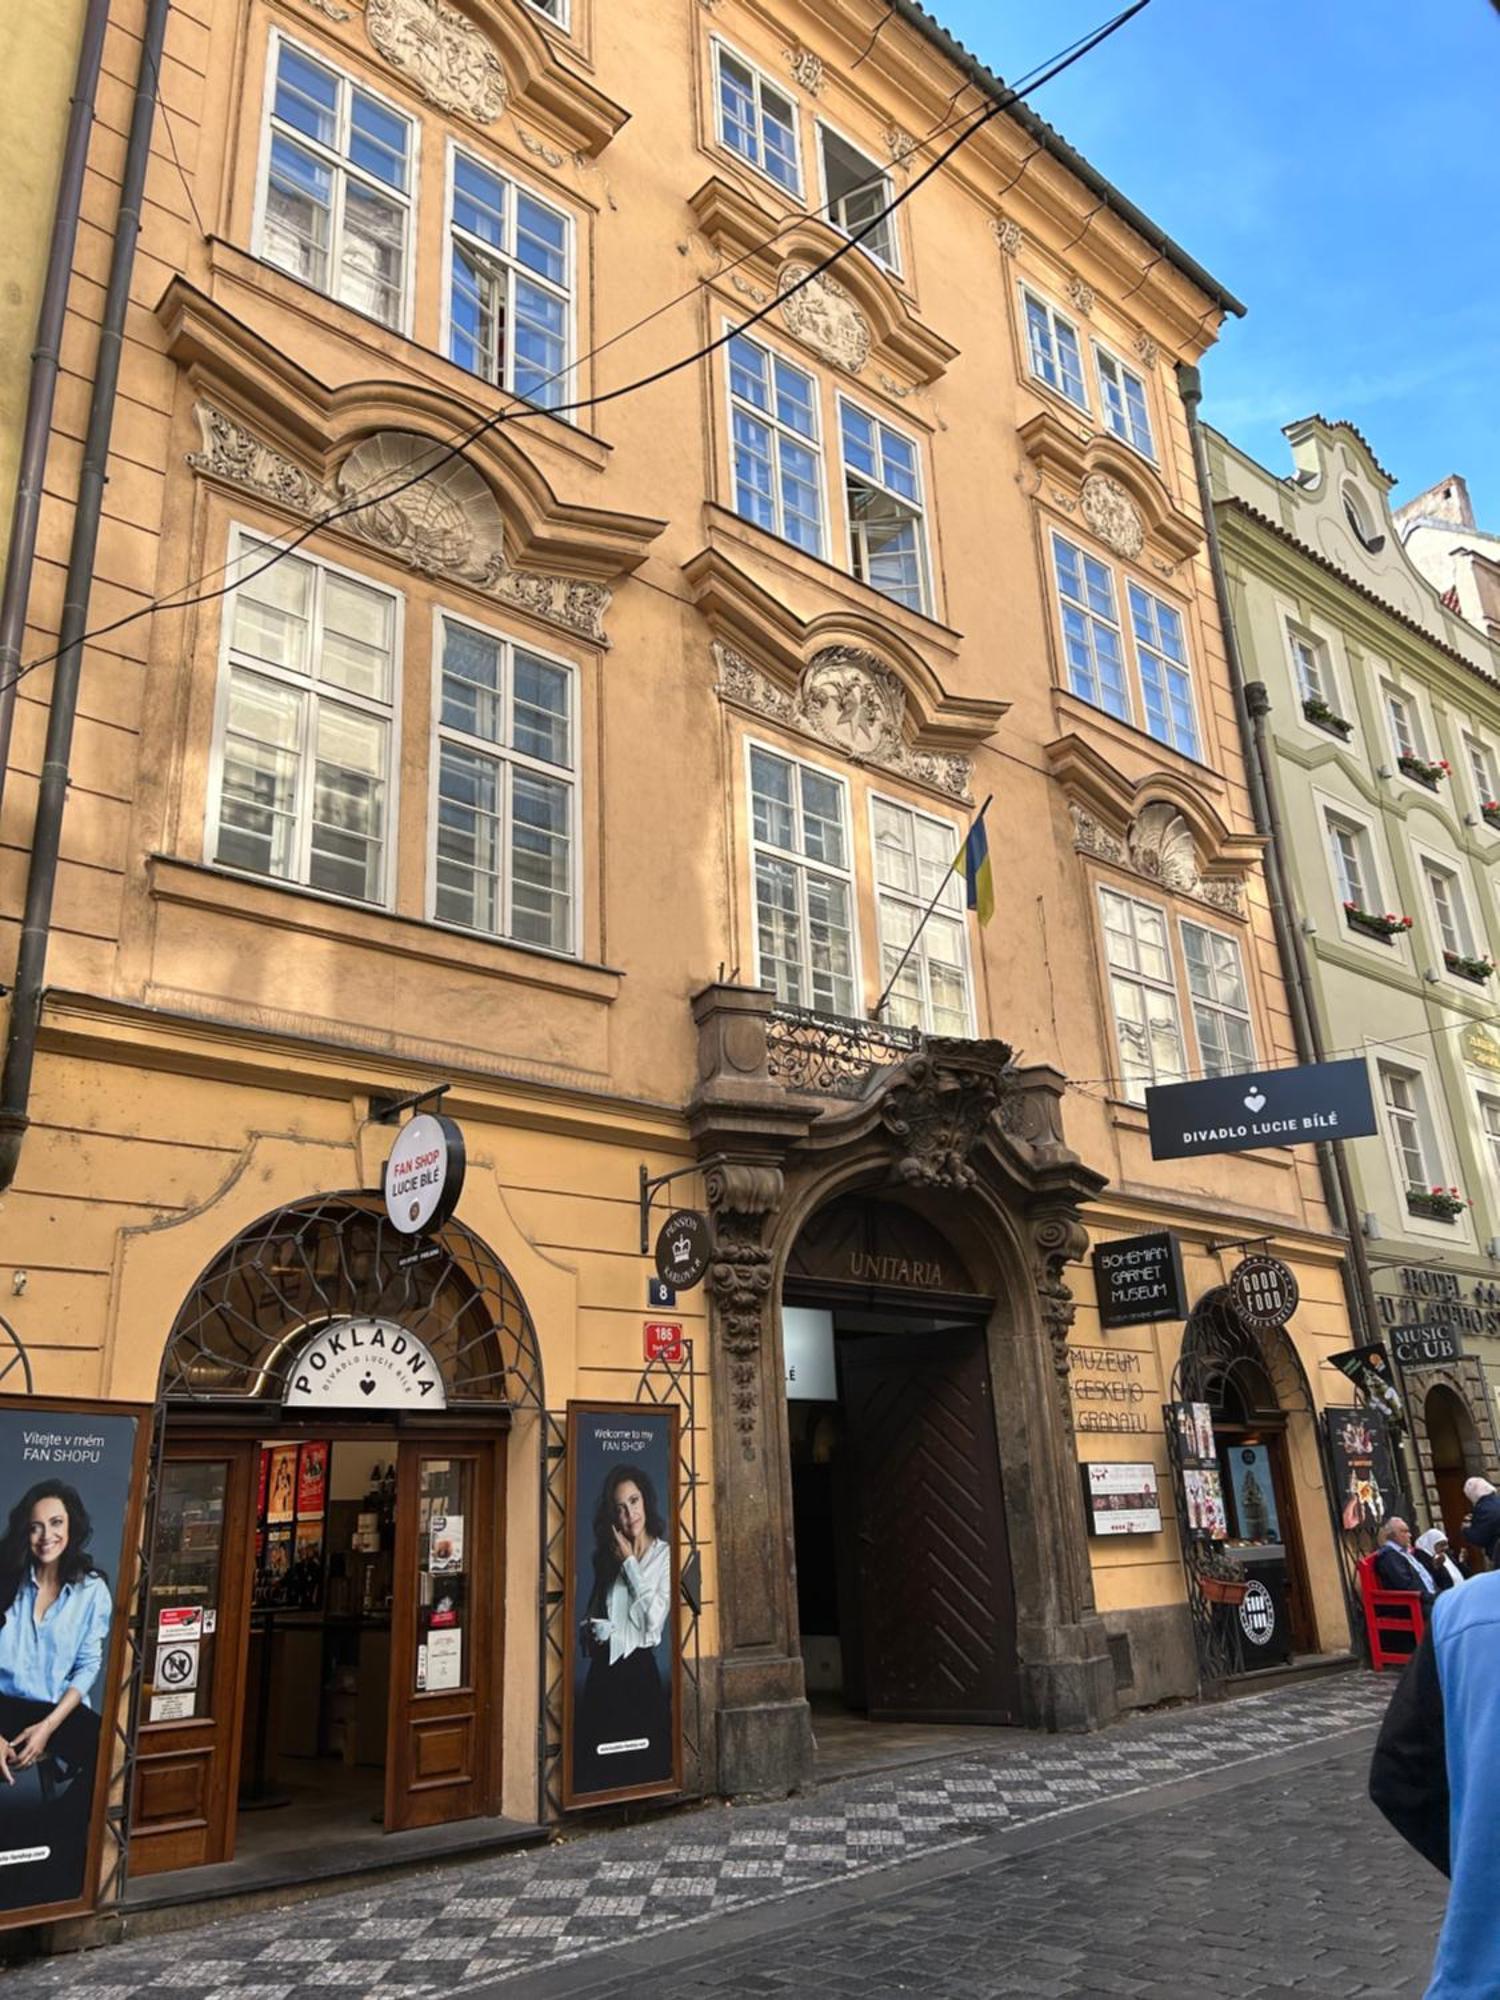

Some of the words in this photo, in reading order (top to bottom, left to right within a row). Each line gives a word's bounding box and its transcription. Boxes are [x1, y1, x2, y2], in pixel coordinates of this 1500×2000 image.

[1183, 1125, 1247, 1143] DIVADLO
[1253, 1119, 1297, 1135] LUCIE
[1303, 1111, 1339, 1129] BÍLÉ
[394, 1159, 413, 1177] FAN
[415, 1149, 440, 1170] SHOP
[392, 1176, 418, 1197] LUCIE
[420, 1164, 440, 1187] BÍLÉ
[665, 1215, 698, 1238] PENSION
[850, 1251, 943, 1286] UNITARIA
[1101, 1247, 1168, 1269] BOHEMIAN
[1111, 1265, 1161, 1286] GARNET
[1242, 1270, 1278, 1292] GOOD
[659, 1284, 668, 1300] 8
[1111, 1284, 1168, 1302] MUSEUM
[1246, 1291, 1282, 1312] FOOD
[1395, 1325, 1450, 1344] MUSIC
[295, 1328, 435, 1396] POKLADNA
[322, 1355, 360, 1391] DIVADLO
[365, 1354, 394, 1369] LUCIE
[1069, 1349, 1141, 1374] MUZEUM
[64, 1435, 72, 1445] v
[594, 1428, 631, 1439] Welcome
[631, 1429, 640, 1439] to
[23, 1447, 51, 1461] FAN
[53, 1449, 101, 1463] SHOPU
[602, 1441, 620, 1451] FAN
[621, 1441, 646, 1451] SHOP
